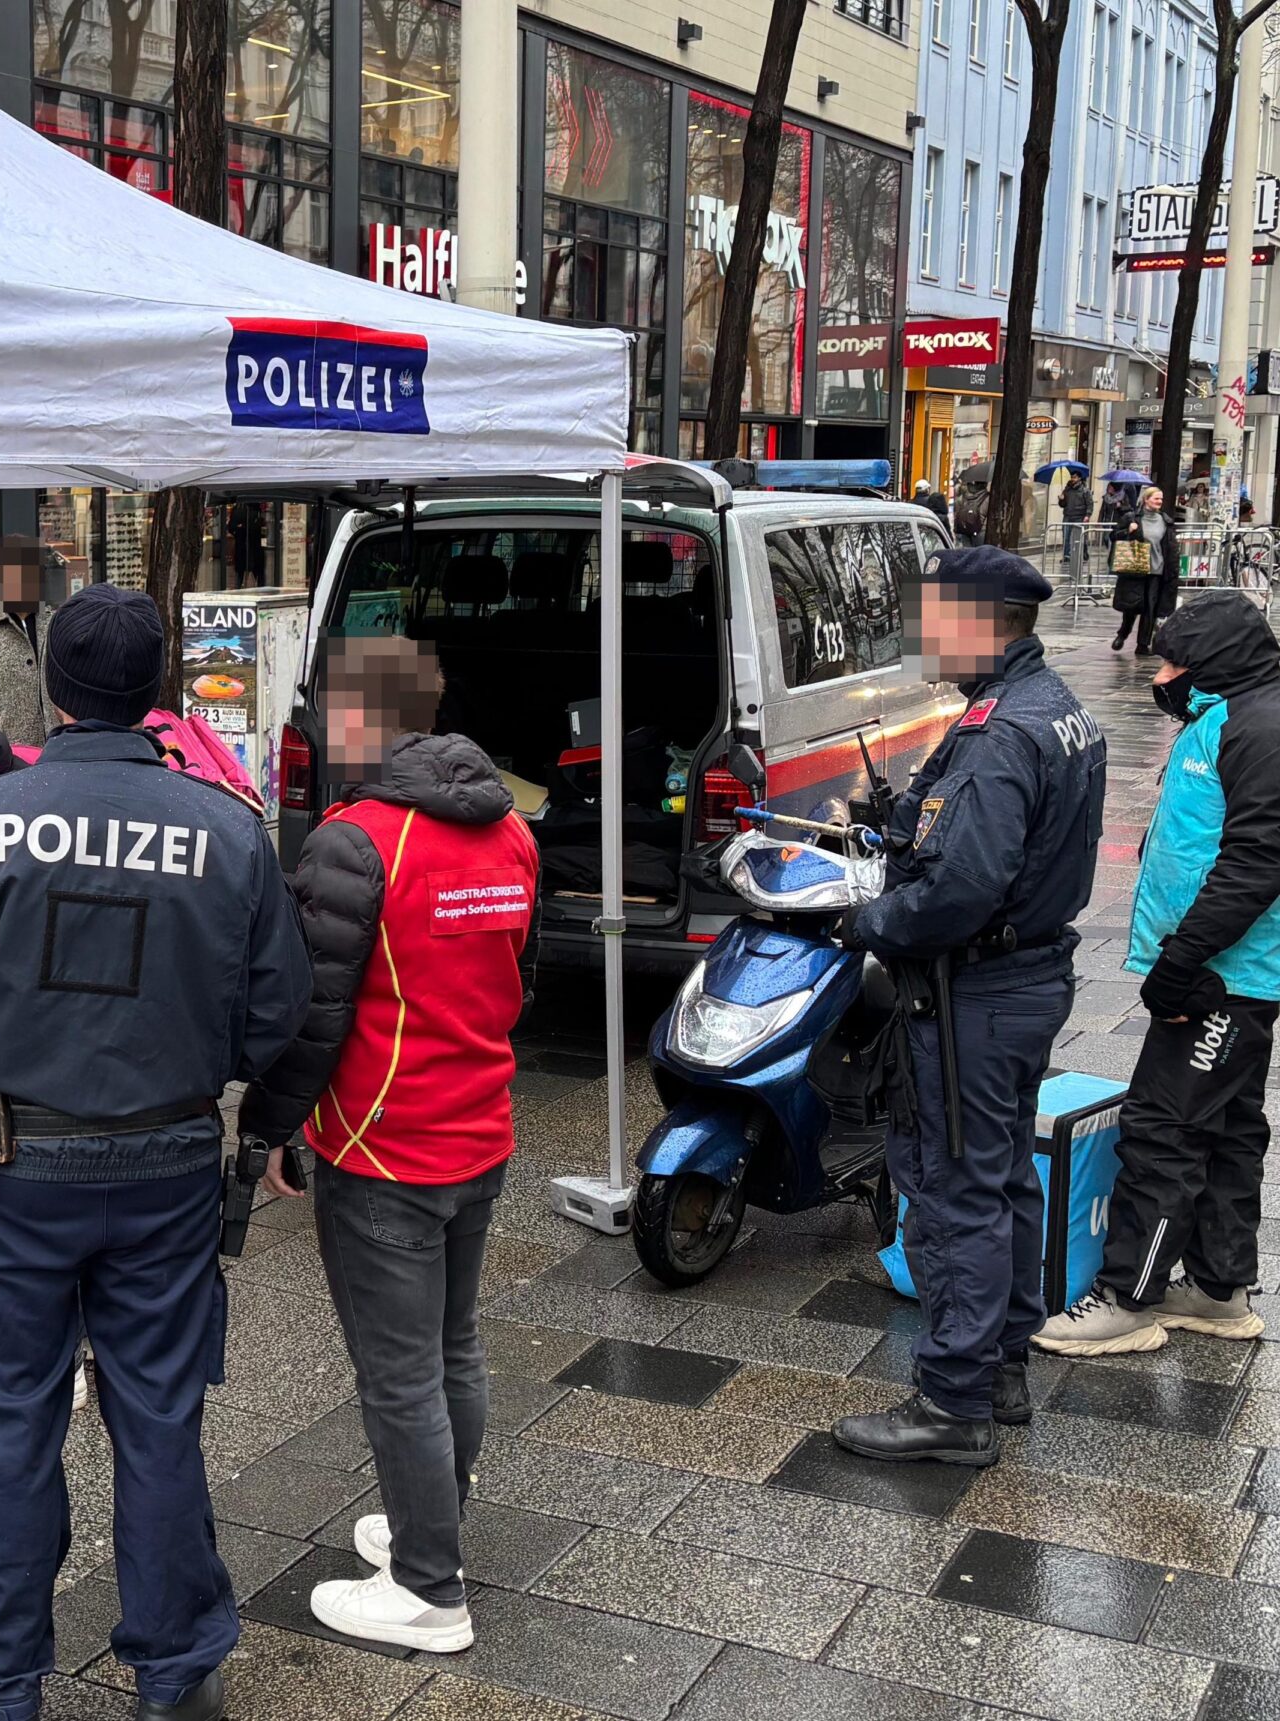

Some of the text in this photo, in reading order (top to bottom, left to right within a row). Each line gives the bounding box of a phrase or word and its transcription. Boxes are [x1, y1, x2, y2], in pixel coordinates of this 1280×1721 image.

[237, 355, 393, 413] POLIZEI
[822, 621, 846, 662] 133
[1182, 757, 1209, 775] Wolt
[434, 906, 467, 919] Gruppe
[1189, 1010, 1232, 1072] Wolt
[1220, 1026, 1240, 1064] PARTNER
